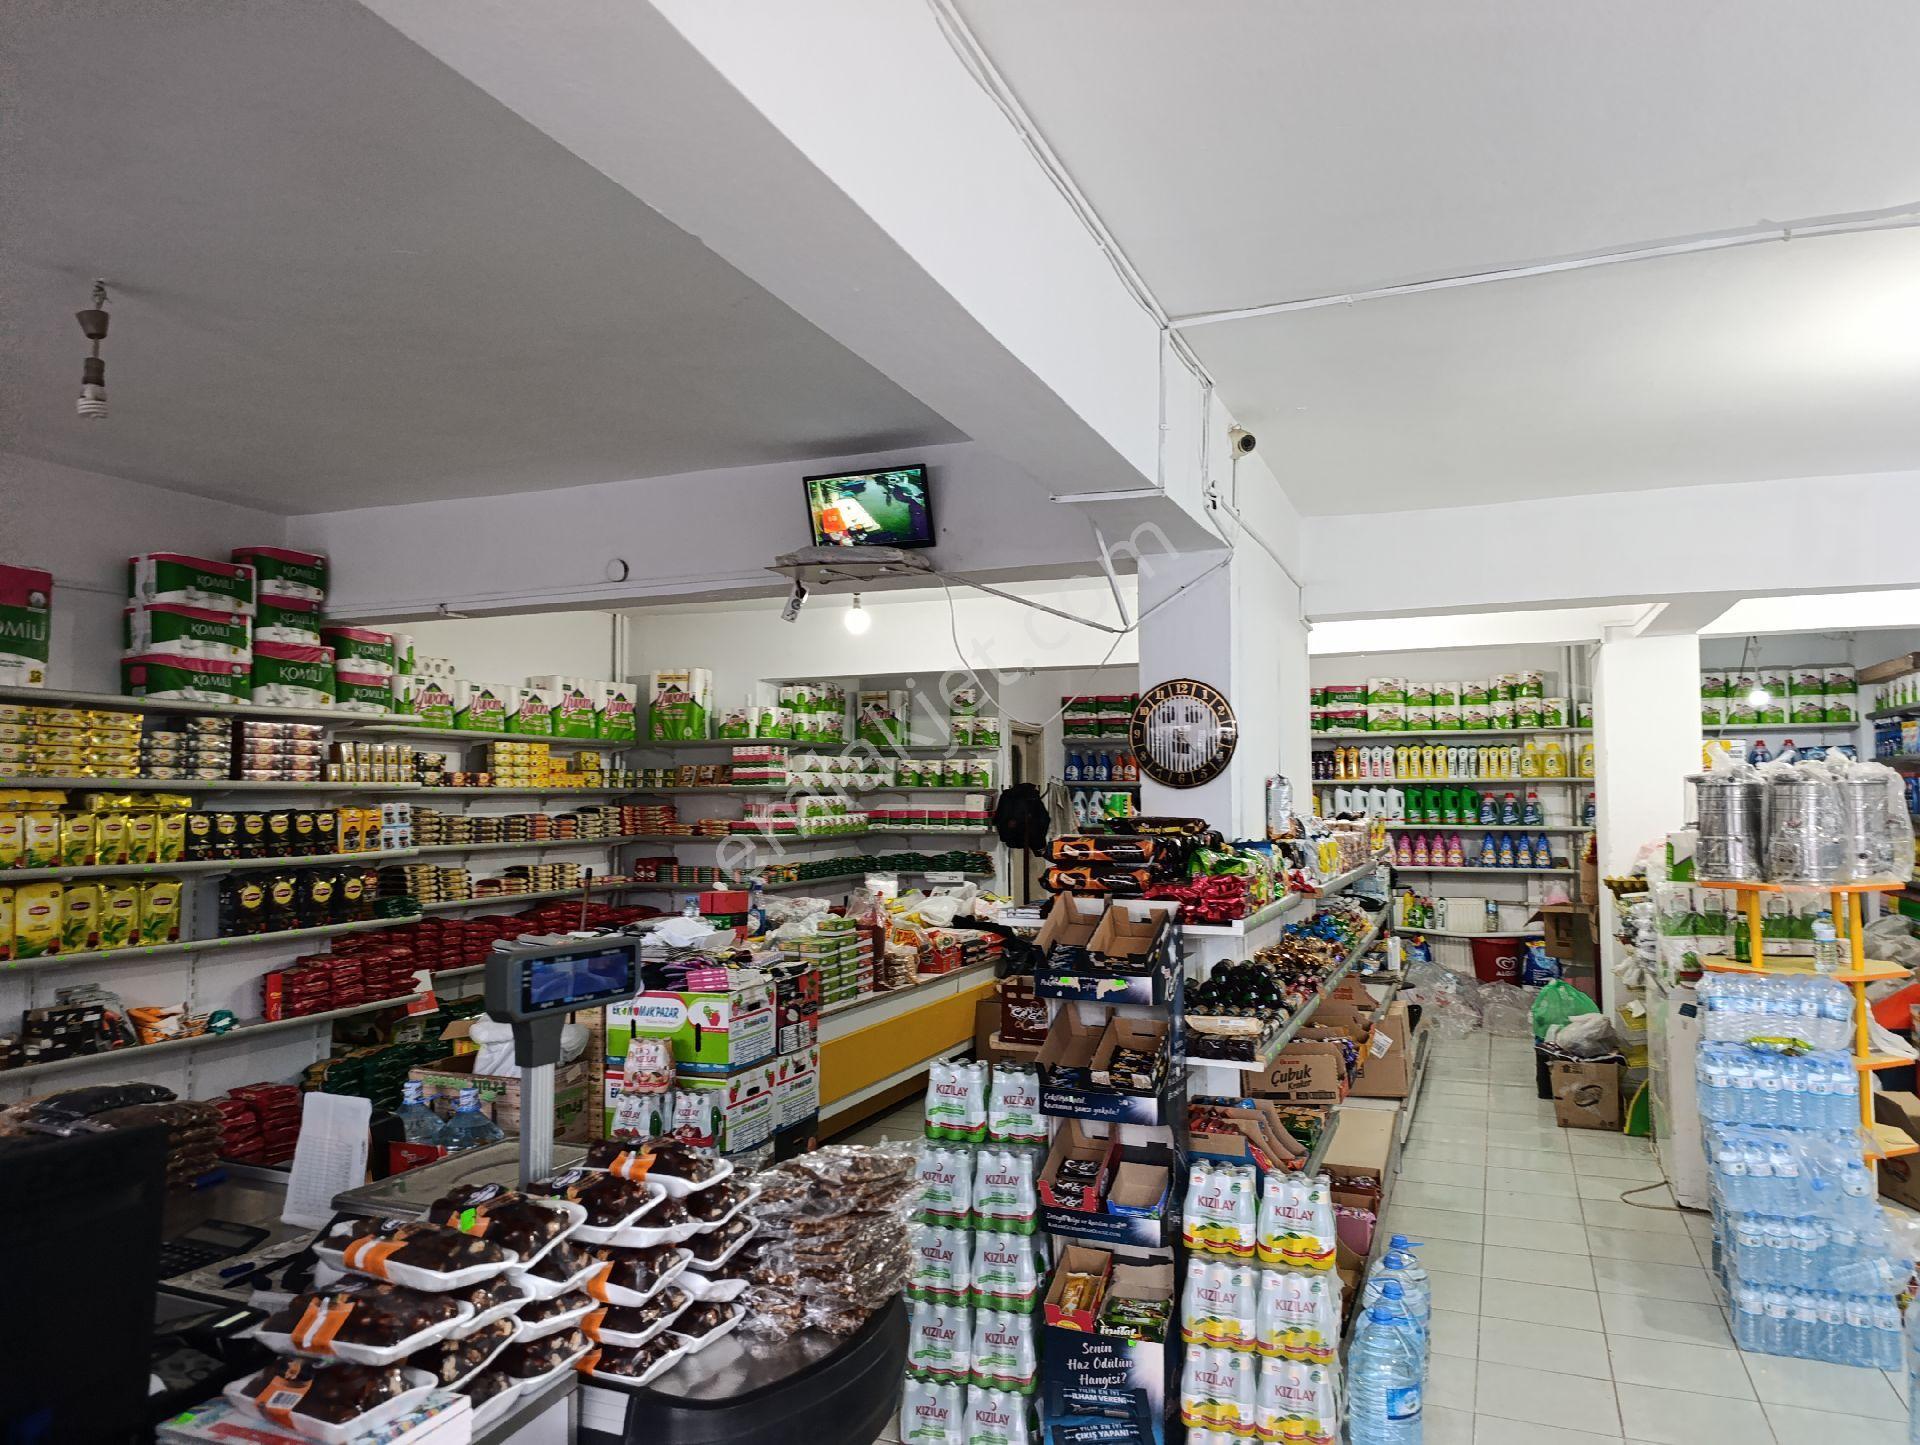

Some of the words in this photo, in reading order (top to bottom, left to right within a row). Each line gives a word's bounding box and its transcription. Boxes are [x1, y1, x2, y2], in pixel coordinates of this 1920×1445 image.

[1176, 684, 1188, 694] 12
[1217, 706, 1225, 715] 2
[1271, 1064, 1312, 1087] Çubuk
[936, 1084, 969, 1097] KIZILAY
[985, 1174, 1020, 1185] KIZILAY
[1197, 1195, 1237, 1211] KIZILAY
[1275, 1206, 1315, 1222] KIZILAY
[921, 1246, 954, 1263] KIZILAY
[983, 1251, 1020, 1265] KIZILAY
[1197, 1288, 1237, 1304] KIZILAY
[1275, 1299, 1317, 1314] KIZILAY
[922, 1325, 956, 1340] KIZILAY
[984, 1332, 1020, 1346] KIZILAY
[1082, 1342, 1113, 1354] Senin
[1067, 1358, 1090, 1370] Haz
[1079, 1372, 1127, 1389] Hangisi?
[1195, 1370, 1235, 1387] KIZILAY
[1275, 1385, 1316, 1401] KIZILAY
[915, 1406, 949, 1420] KIZILAY
[975, 1410, 1010, 1426] KIZILAY
[1099, 1429, 1129, 1439] YAPANI
